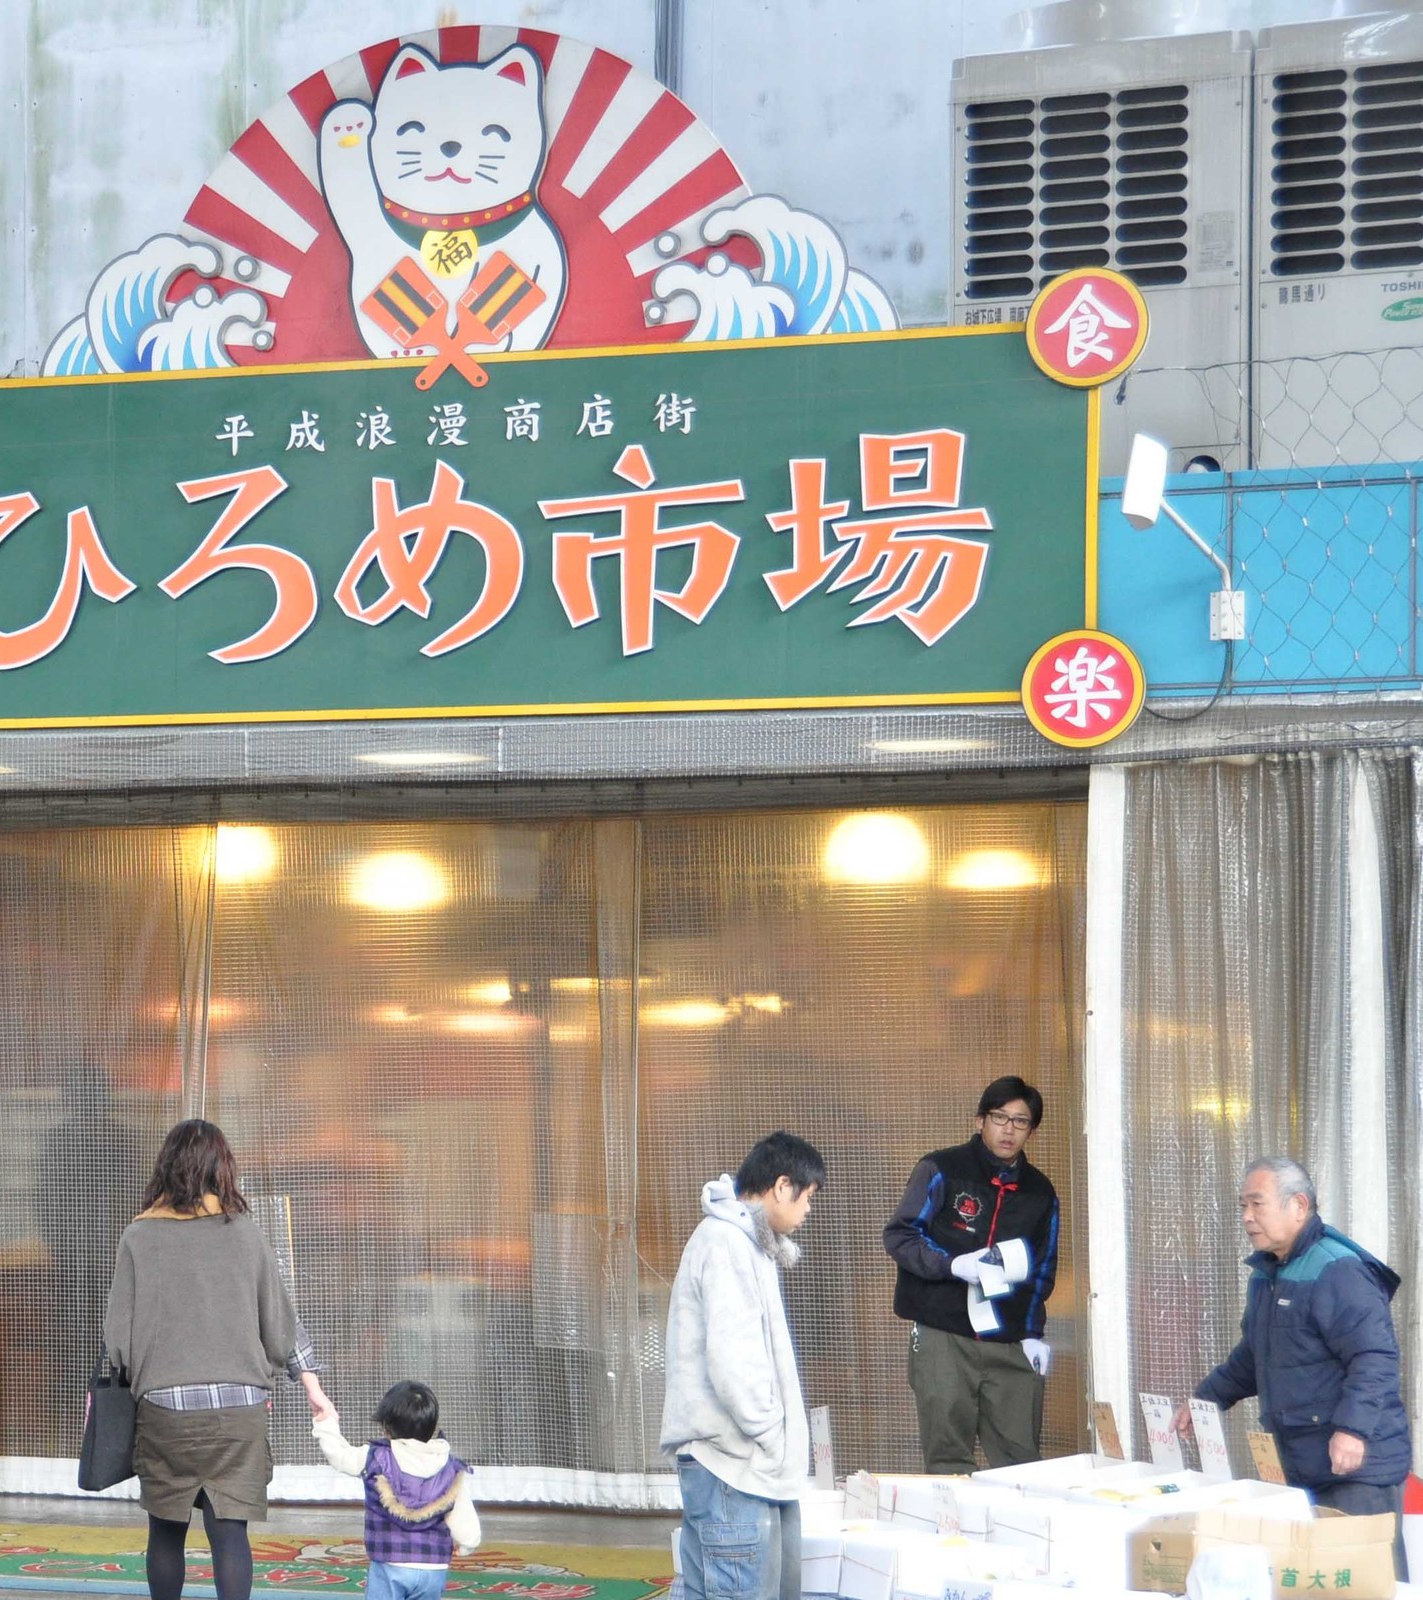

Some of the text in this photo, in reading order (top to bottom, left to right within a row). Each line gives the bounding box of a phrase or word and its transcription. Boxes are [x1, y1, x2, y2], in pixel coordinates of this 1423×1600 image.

[430, 233, 473, 274] 福
[1380, 281, 1423, 293] TOSHI
[1044, 283, 1131, 368] 食
[215, 392, 698, 456] 平成浪漫商店街
[1043, 647, 1122, 728] 楽
